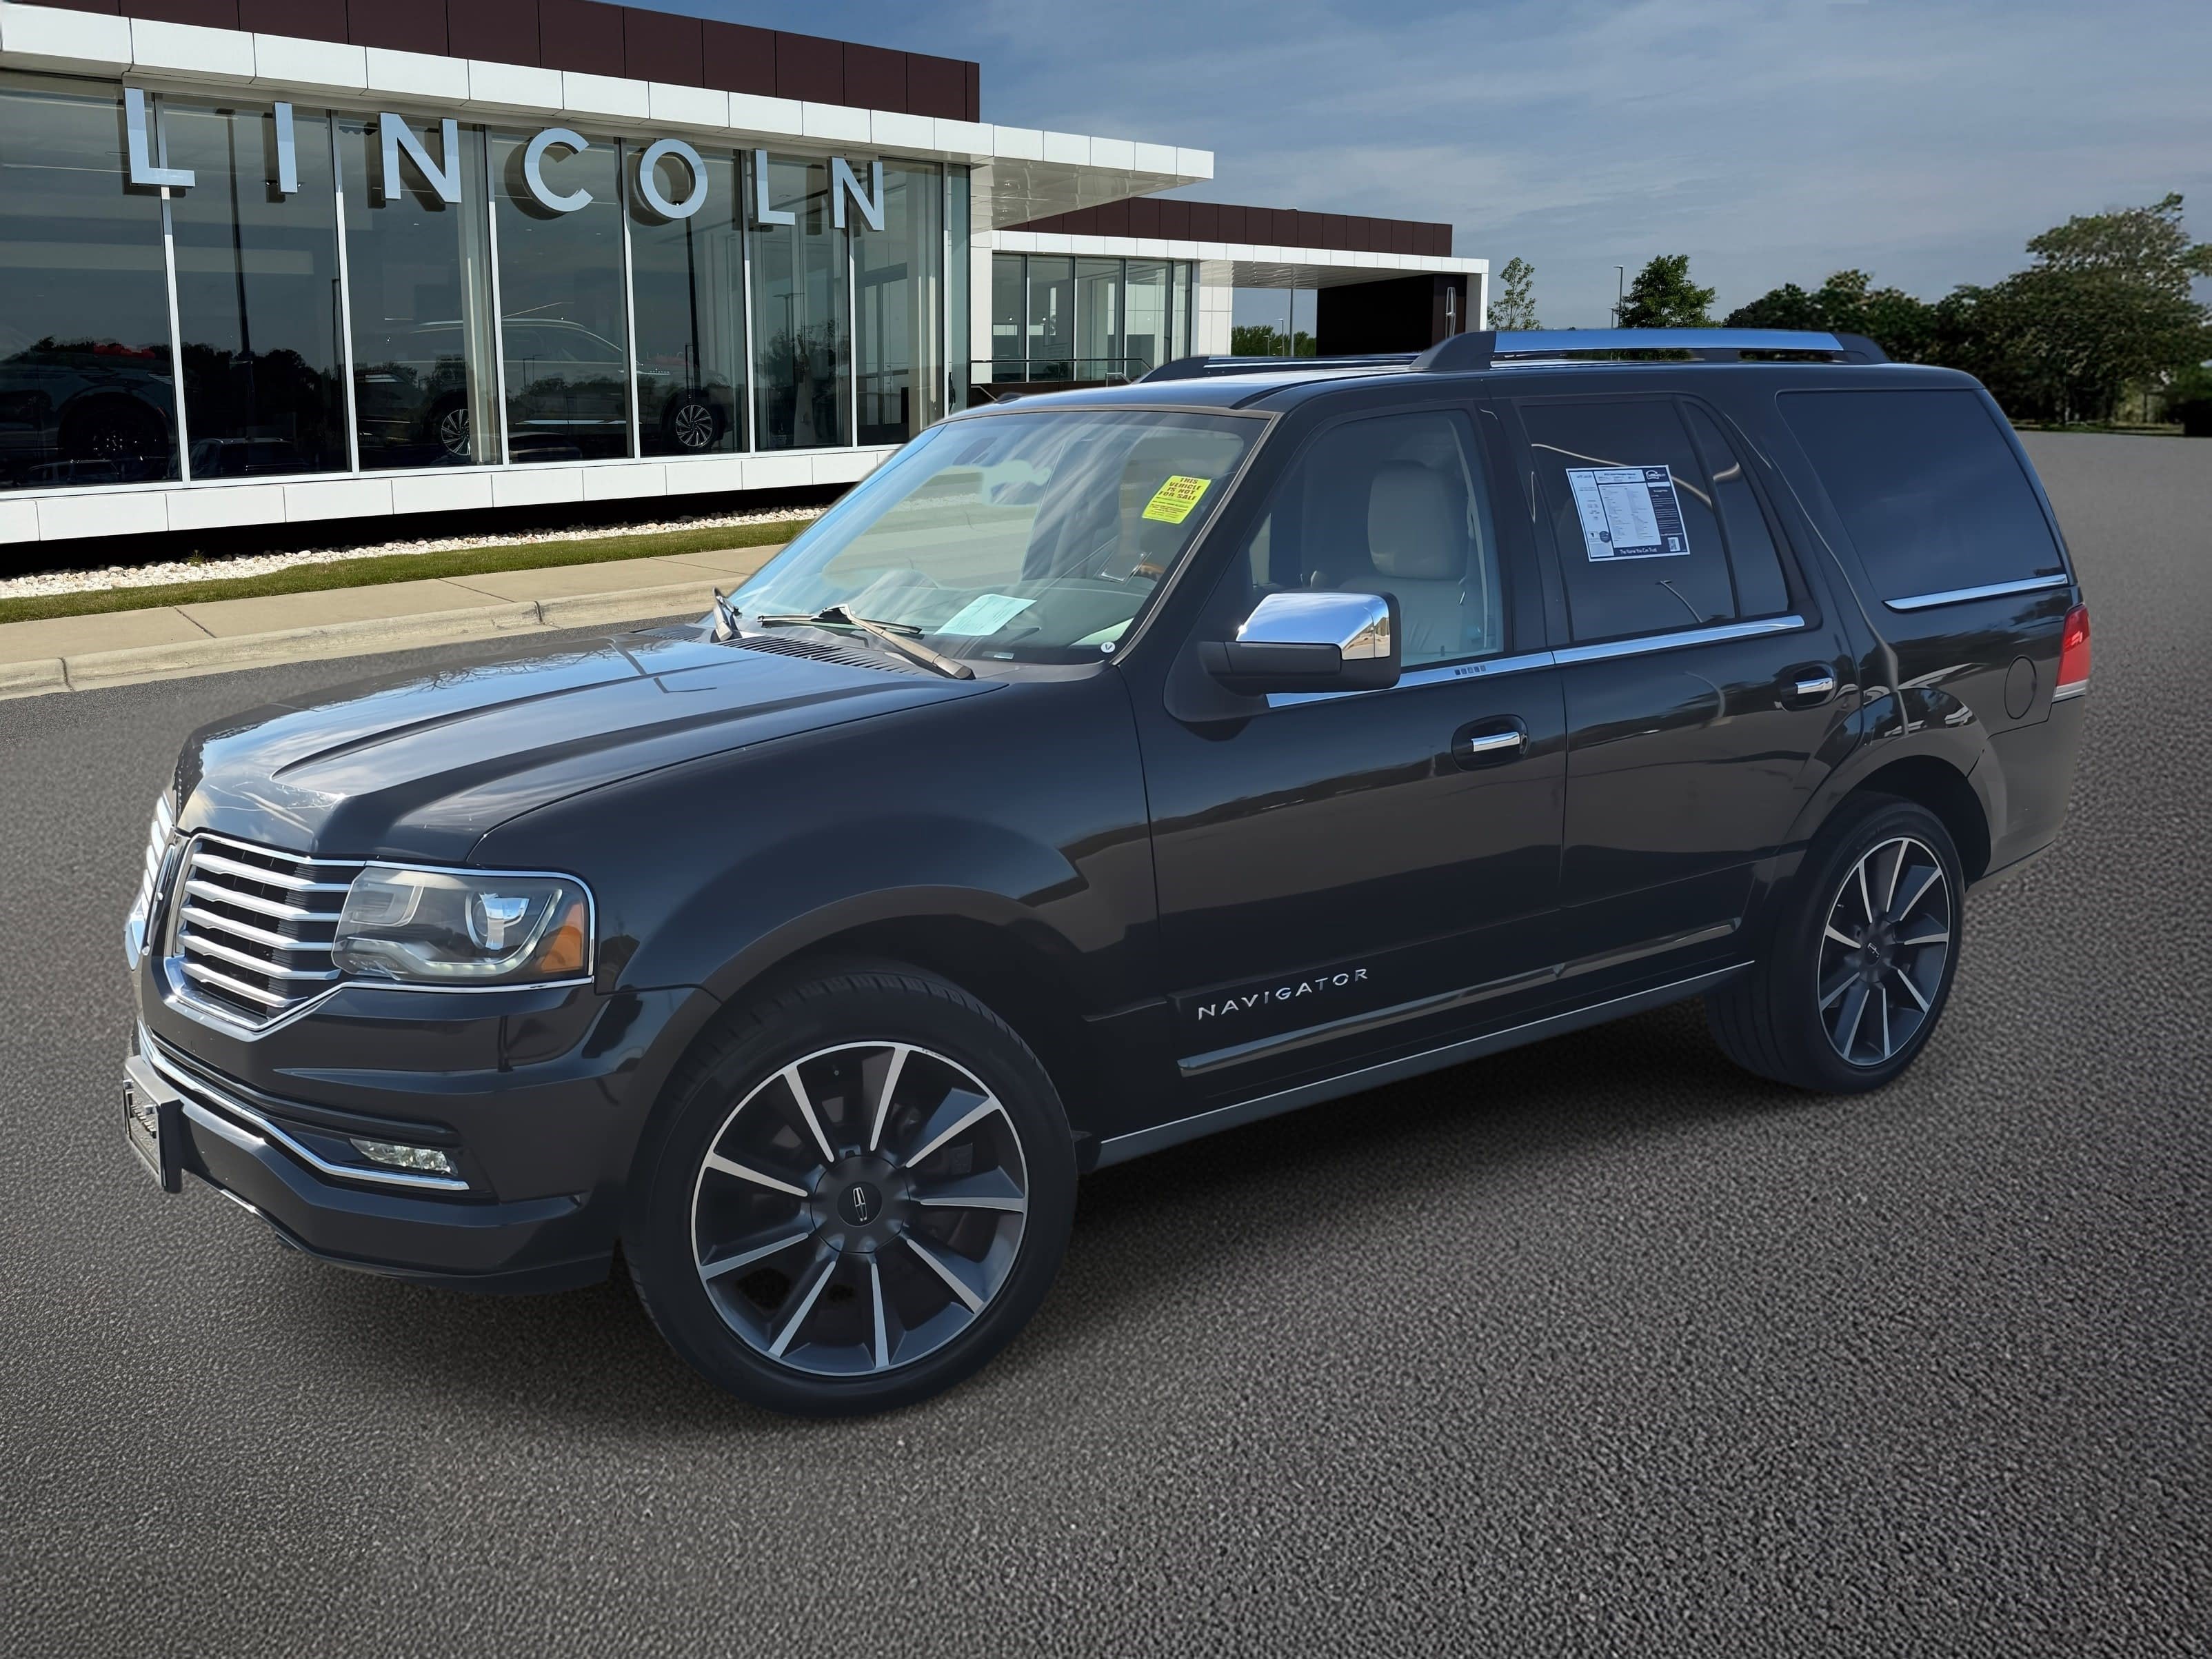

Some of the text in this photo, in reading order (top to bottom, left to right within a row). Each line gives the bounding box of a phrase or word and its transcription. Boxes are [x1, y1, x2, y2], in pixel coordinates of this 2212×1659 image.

[124, 87, 884, 232] LINCOLN
[1169, 481, 1202, 490] VEHICLE
[1198, 968, 1368, 1020] NAVIGATOR
